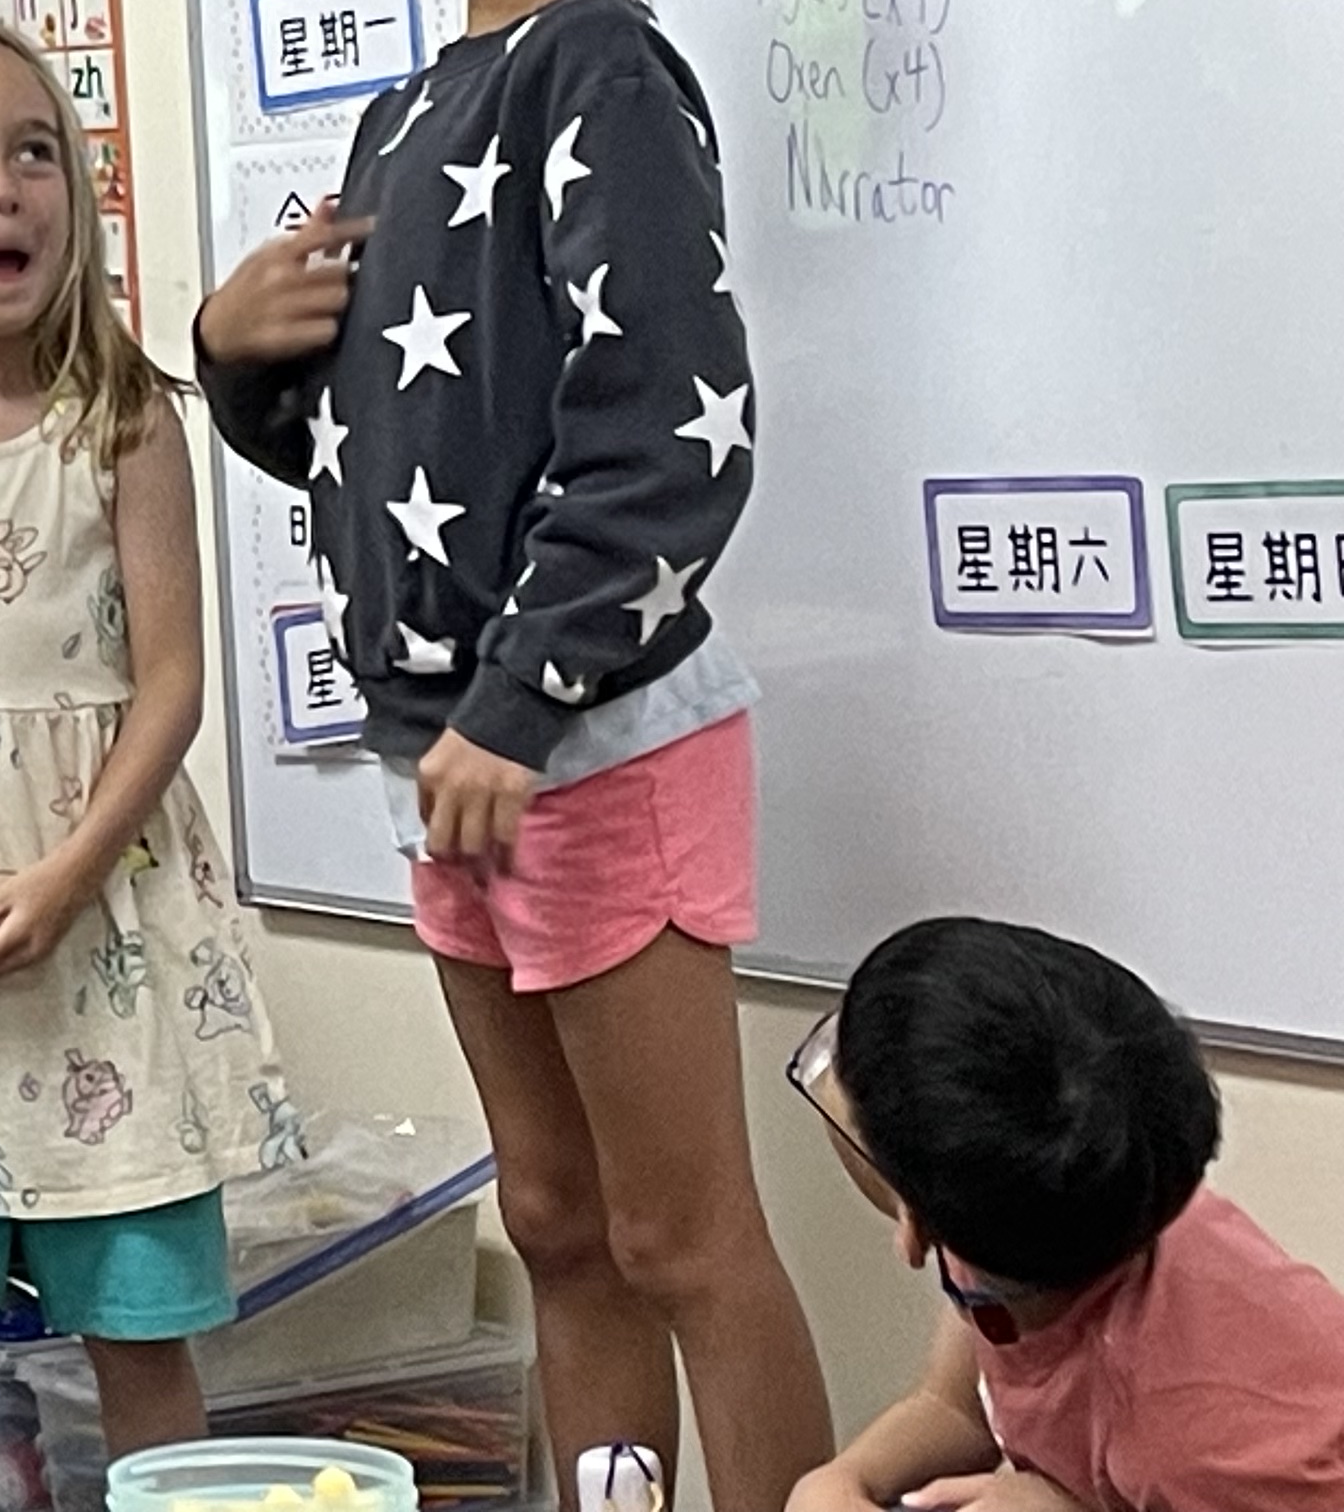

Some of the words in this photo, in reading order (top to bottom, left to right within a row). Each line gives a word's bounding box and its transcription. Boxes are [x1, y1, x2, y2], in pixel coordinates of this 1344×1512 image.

[72, 55, 104, 99] zh
[280, 10, 396, 77] 星期一
[767, 38, 845, 103] Oxen
[862, 39, 945, 132] (x4)
[786, 120, 955, 224] Narrator
[958, 523, 1109, 593] 星期六
